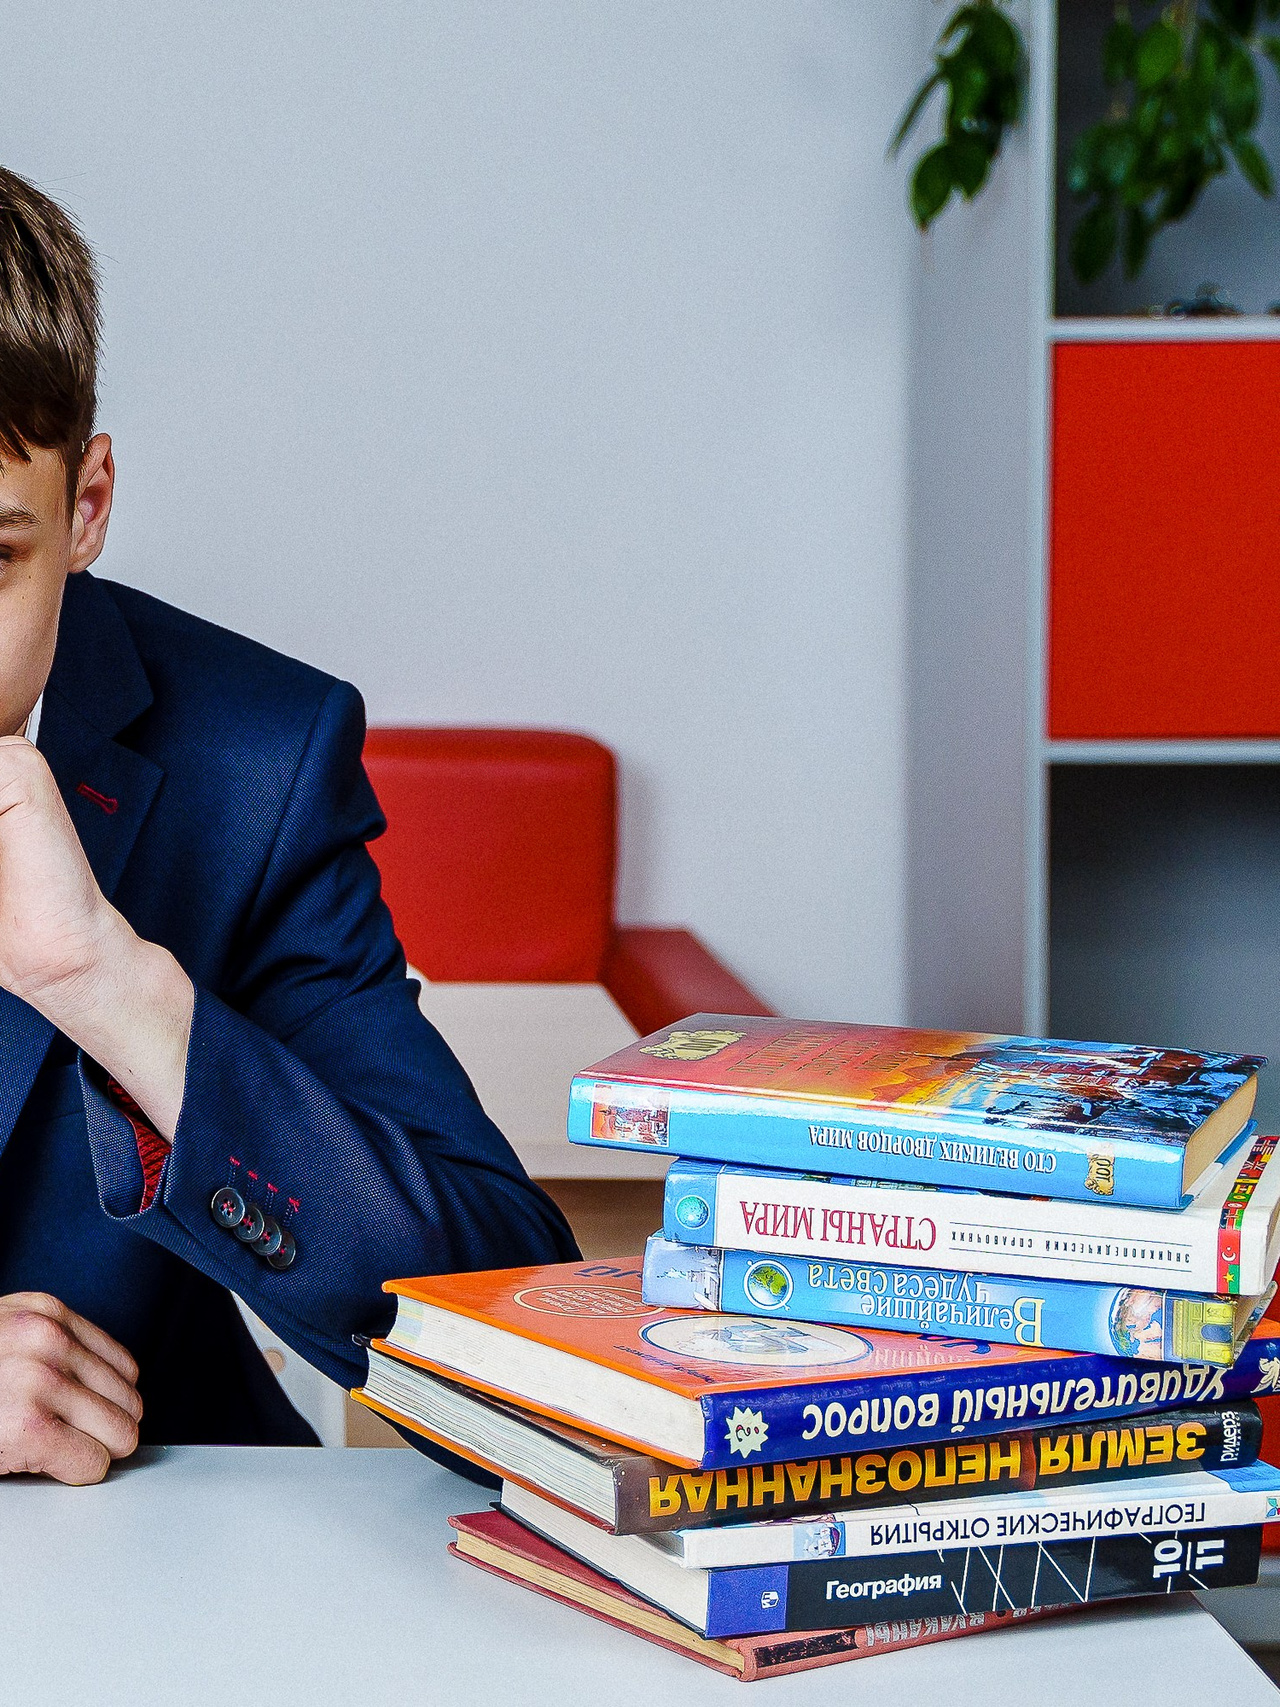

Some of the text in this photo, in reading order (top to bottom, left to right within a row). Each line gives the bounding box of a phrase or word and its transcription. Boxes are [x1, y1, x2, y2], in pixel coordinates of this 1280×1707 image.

[808, 1125, 1057, 1174] СТО ВЕЛИКИХ ДВОРЦОВ МИРА
[740, 1201, 937, 1252] СТРАНЫ МИРА
[951, 1231, 1190, 1263] ЭНЦИКЛОПЕДИЧЕСКИЙ СПРАВОЧНИК
[808, 1264, 888, 1294] света
[861, 1295, 1044, 1346] Величайшие
[649, 1422, 1207, 1517] ЗЕМЛЯ НЕПОЗНАННАЯ
[869, 1502, 1205, 1547] ГЕОГРАФИЧЕСКИЕ ОТКРЫТИЯ
[1153, 1539, 1183, 1579] 10
[1195, 1539, 1225, 1570] 11
[826, 1573, 942, 1600] География
